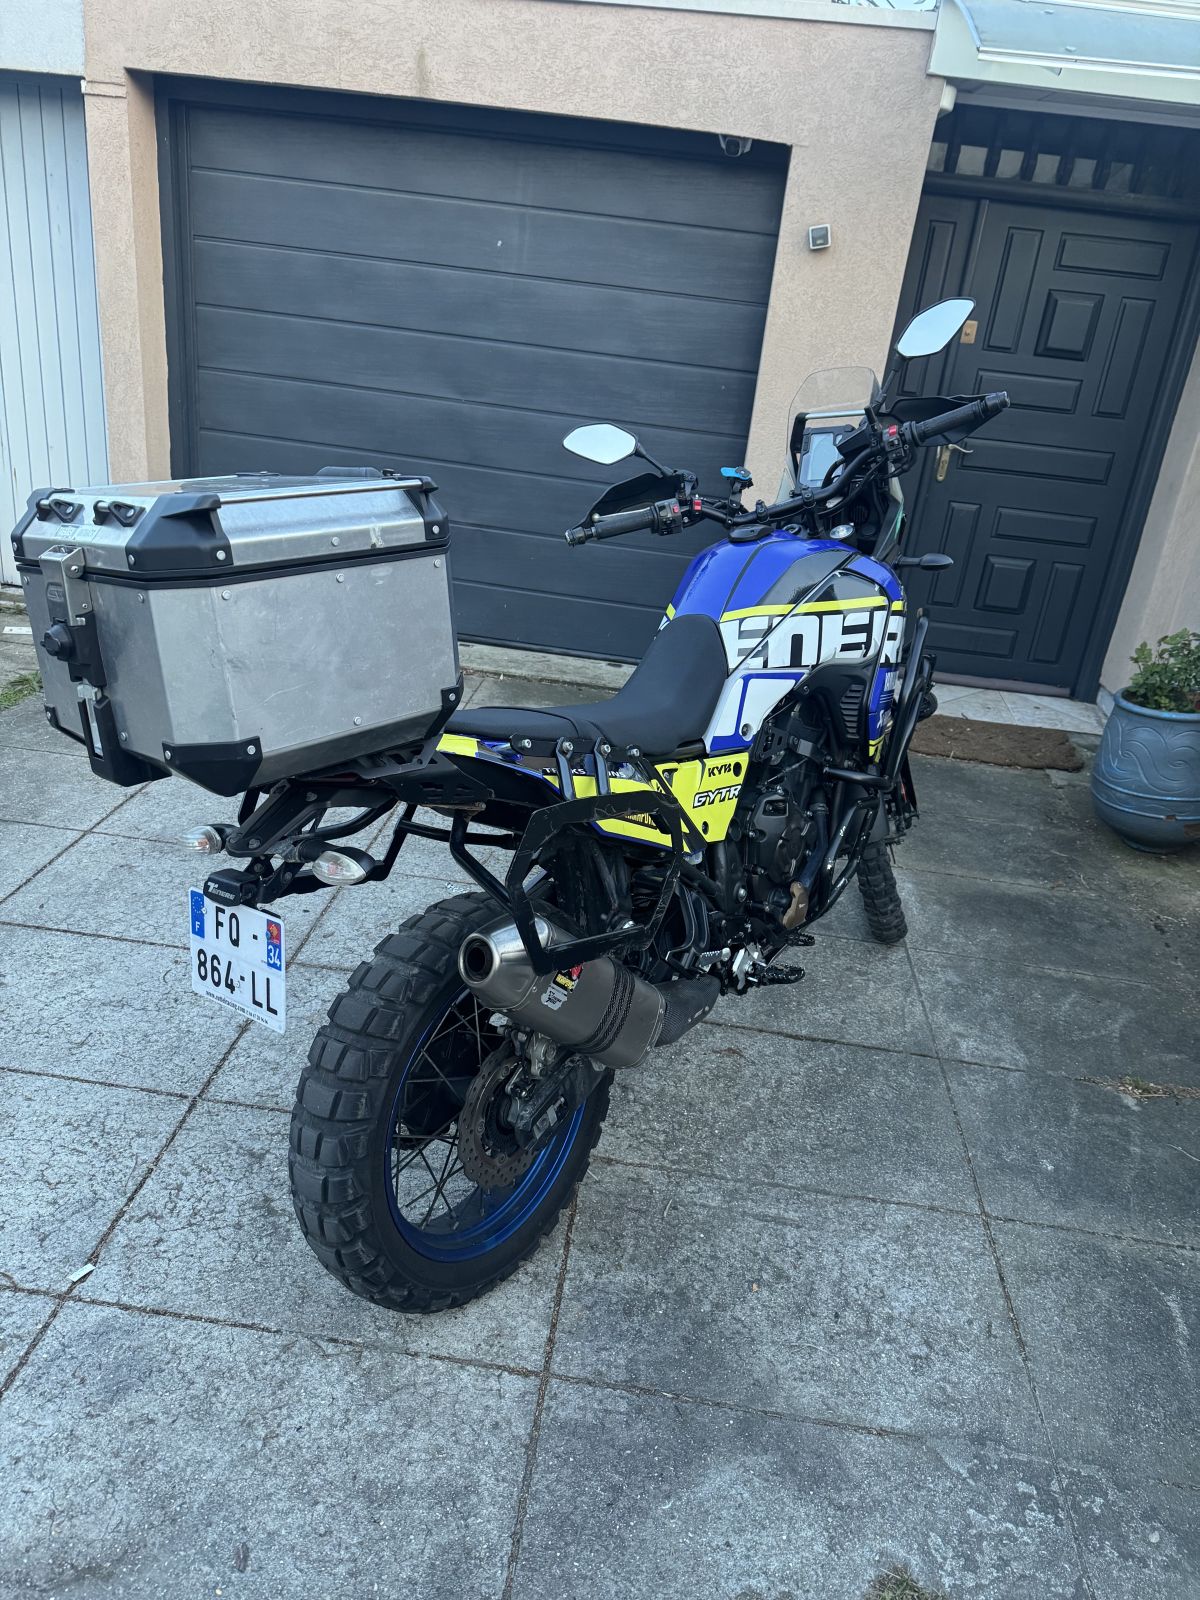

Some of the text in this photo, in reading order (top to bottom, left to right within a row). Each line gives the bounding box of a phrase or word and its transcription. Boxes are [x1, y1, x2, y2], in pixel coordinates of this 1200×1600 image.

[708, 763, 732, 777] KYB
[692, 784, 742, 809] GYTR
[195, 921, 201, 933] F
[268, 944, 281, 967] 34
[197, 948, 278, 1016] 864-LL
